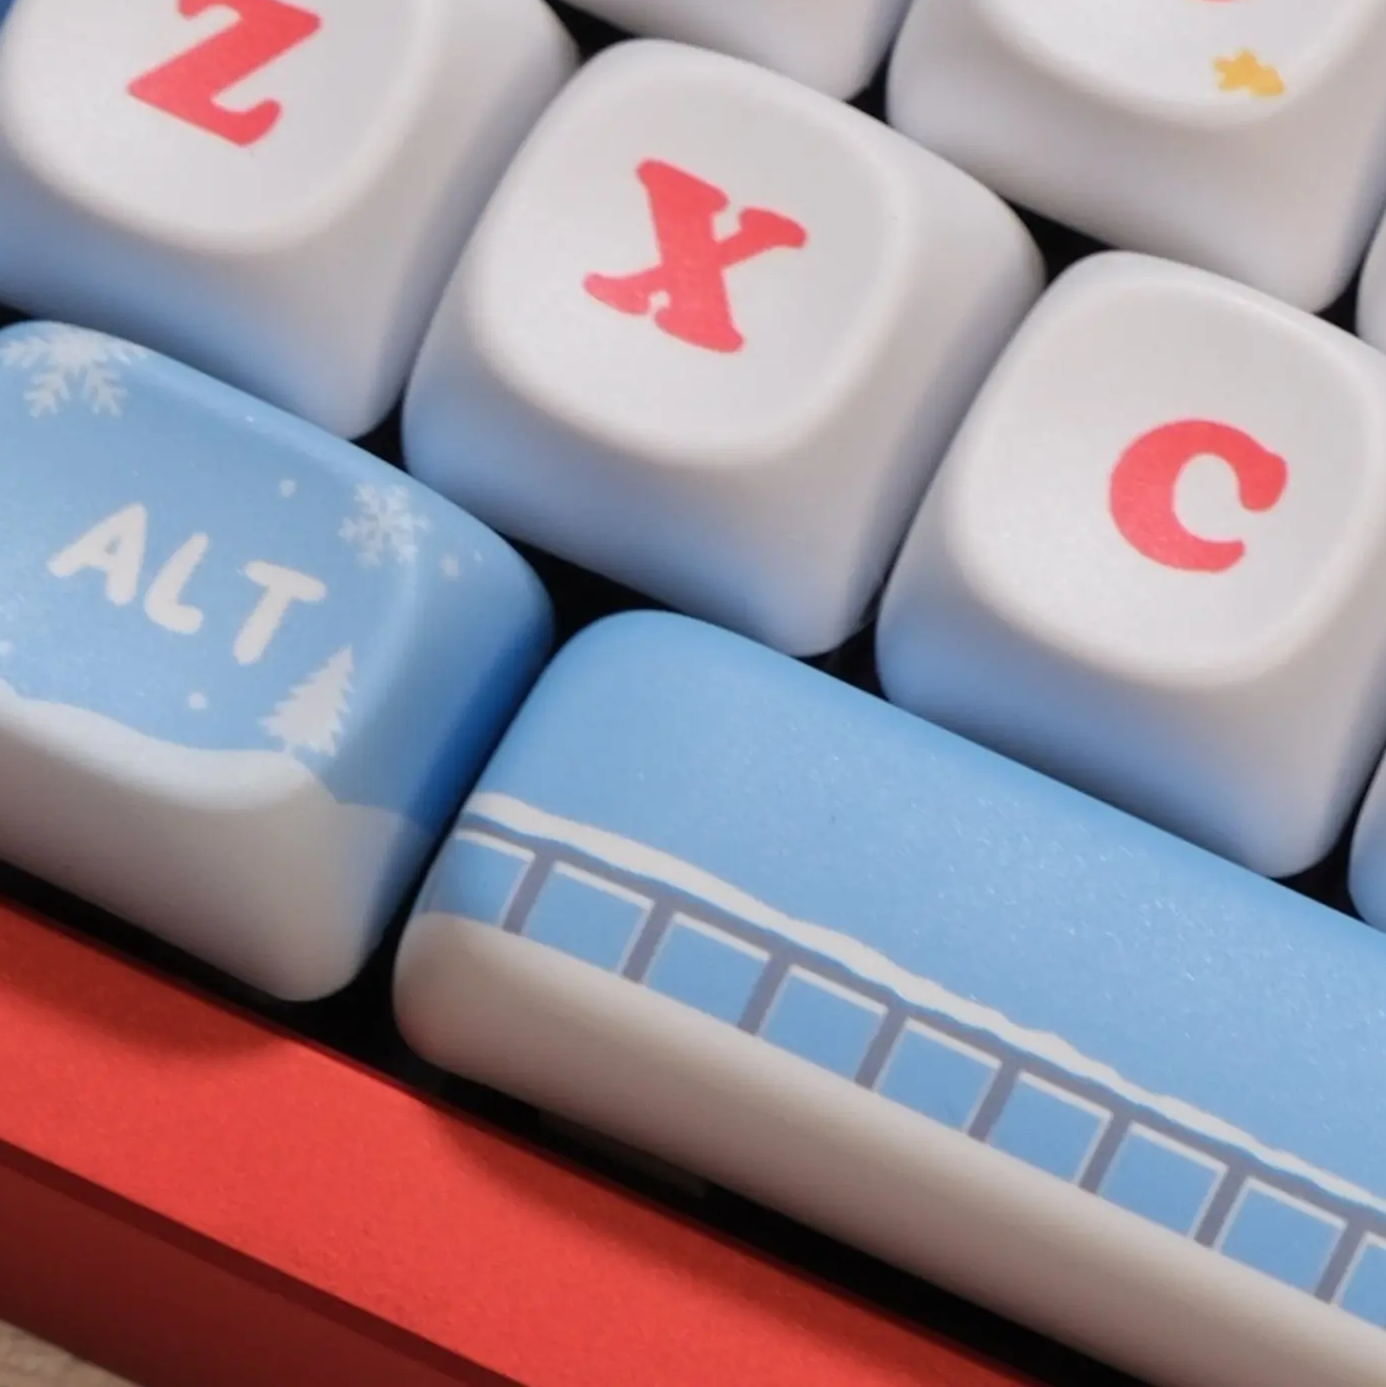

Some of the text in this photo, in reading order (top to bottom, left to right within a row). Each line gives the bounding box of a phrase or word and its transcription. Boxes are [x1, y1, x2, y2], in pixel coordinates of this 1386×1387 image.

[583, 158, 808, 354] X
[1108, 418, 1290, 573] C
[47, 500, 326, 665] ALT
